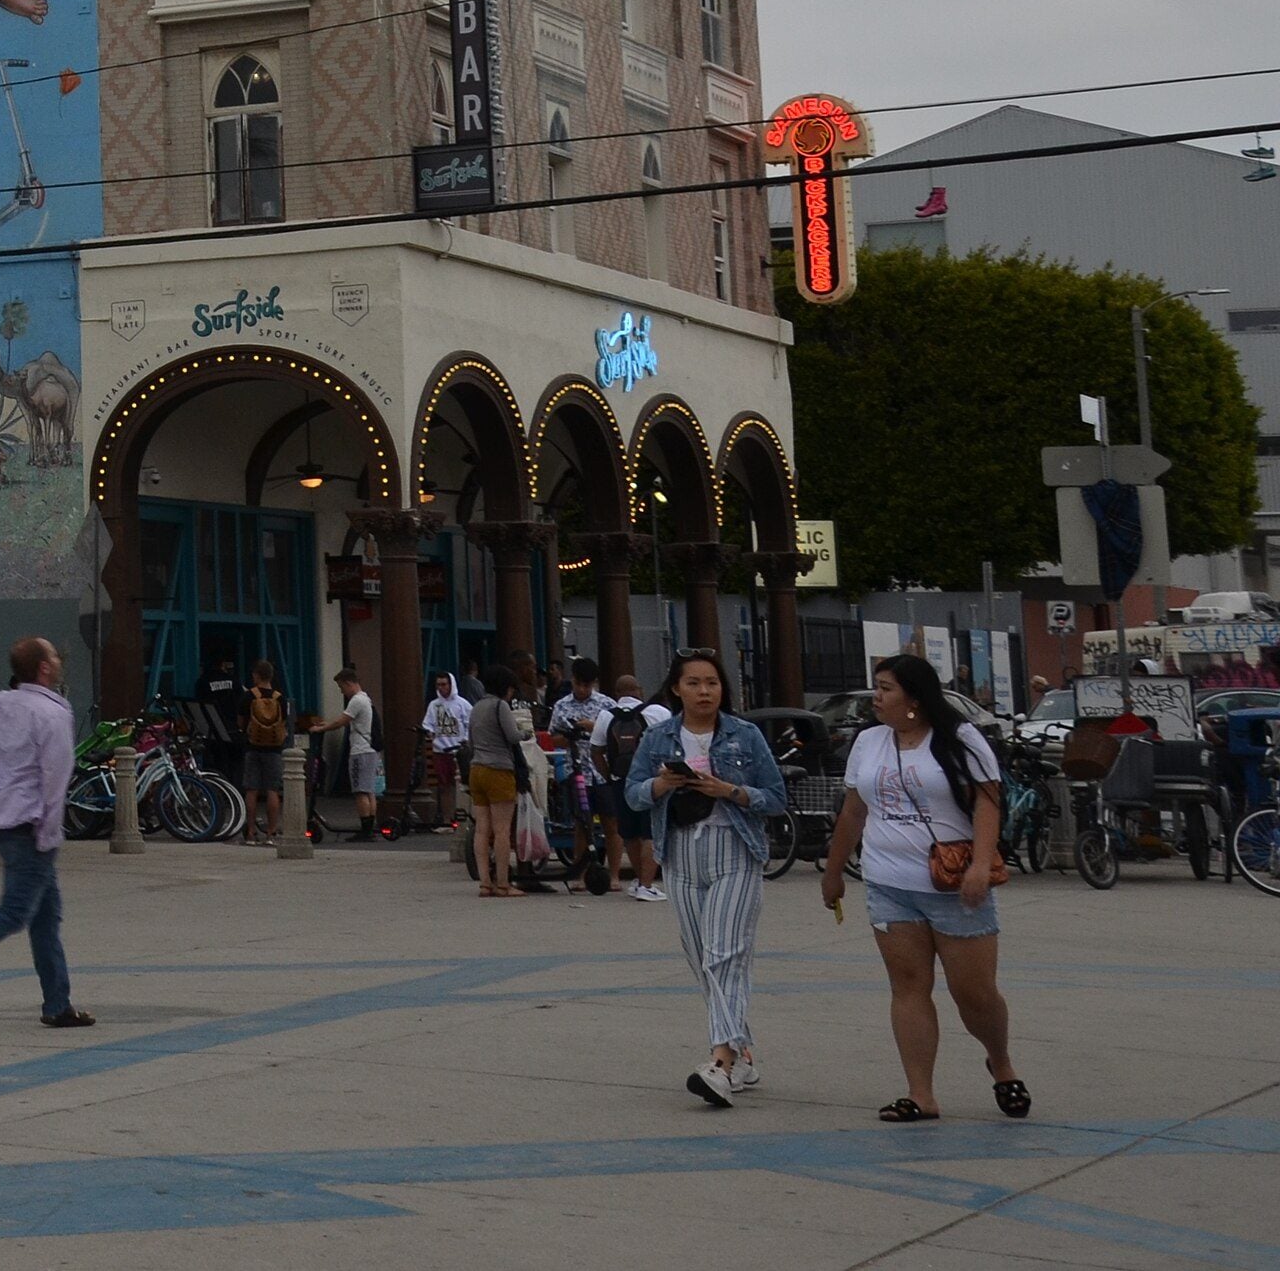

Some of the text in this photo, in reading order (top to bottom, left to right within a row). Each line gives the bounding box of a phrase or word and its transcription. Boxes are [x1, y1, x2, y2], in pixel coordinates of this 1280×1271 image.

[766, 97, 859, 147] SAMESUN
[419, 154, 488, 191] Surfside
[119, 321, 139, 329] LATE
[192, 286, 284, 337] Surfside
[258, 328, 392, 407] SPORT SURF MUSIC
[595, 312, 658, 392] Surfside
[93, 339, 189, 421] RESTAURANT BAR
[797, 530, 824, 544] LIC
